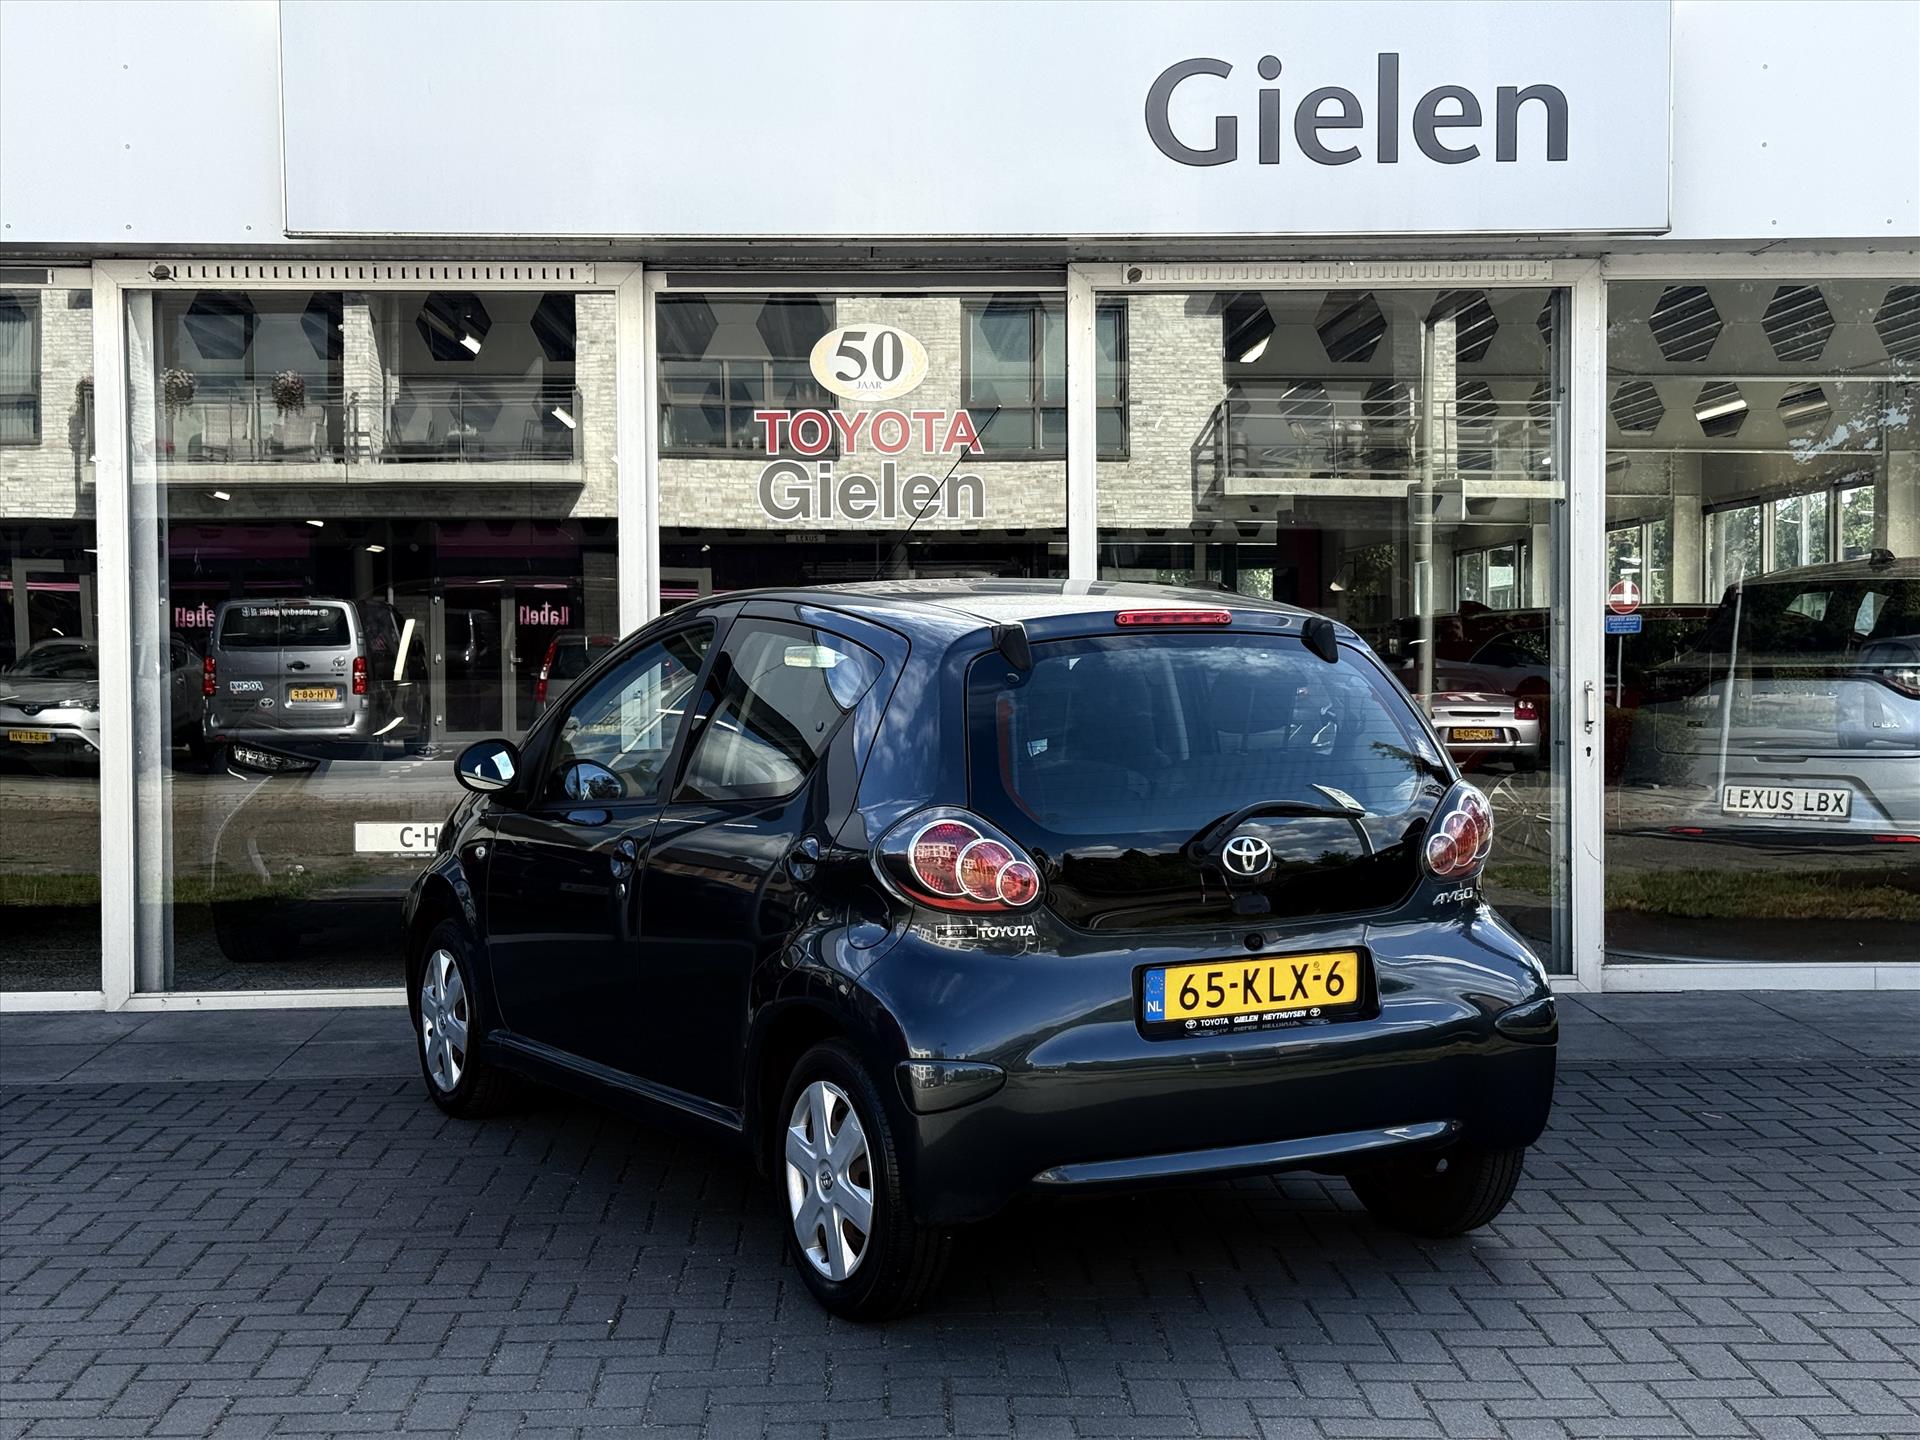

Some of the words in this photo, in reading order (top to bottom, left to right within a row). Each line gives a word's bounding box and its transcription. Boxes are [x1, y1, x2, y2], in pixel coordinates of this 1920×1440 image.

[1145, 53, 1568, 167] Gielen
[835, 331, 904, 382] 50
[857, 381, 882, 390] JAAR
[754, 409, 985, 456] TOYOTA
[757, 459, 986, 521] Gielen
[1726, 789, 1794, 811] LEXUS
[1803, 792, 1845, 813] LBX
[1432, 887, 1473, 906] AYGO
[978, 925, 1035, 938] TOYOTA
[1178, 961, 1345, 1011] 65-KLX-6
[1147, 1000, 1163, 1013] NL
[1200, 1018, 1230, 1027] TOYOTA
[1233, 1014, 1259, 1024] GIELEN
[1262, 1009, 1307, 1021] HEYTHUYSEN
